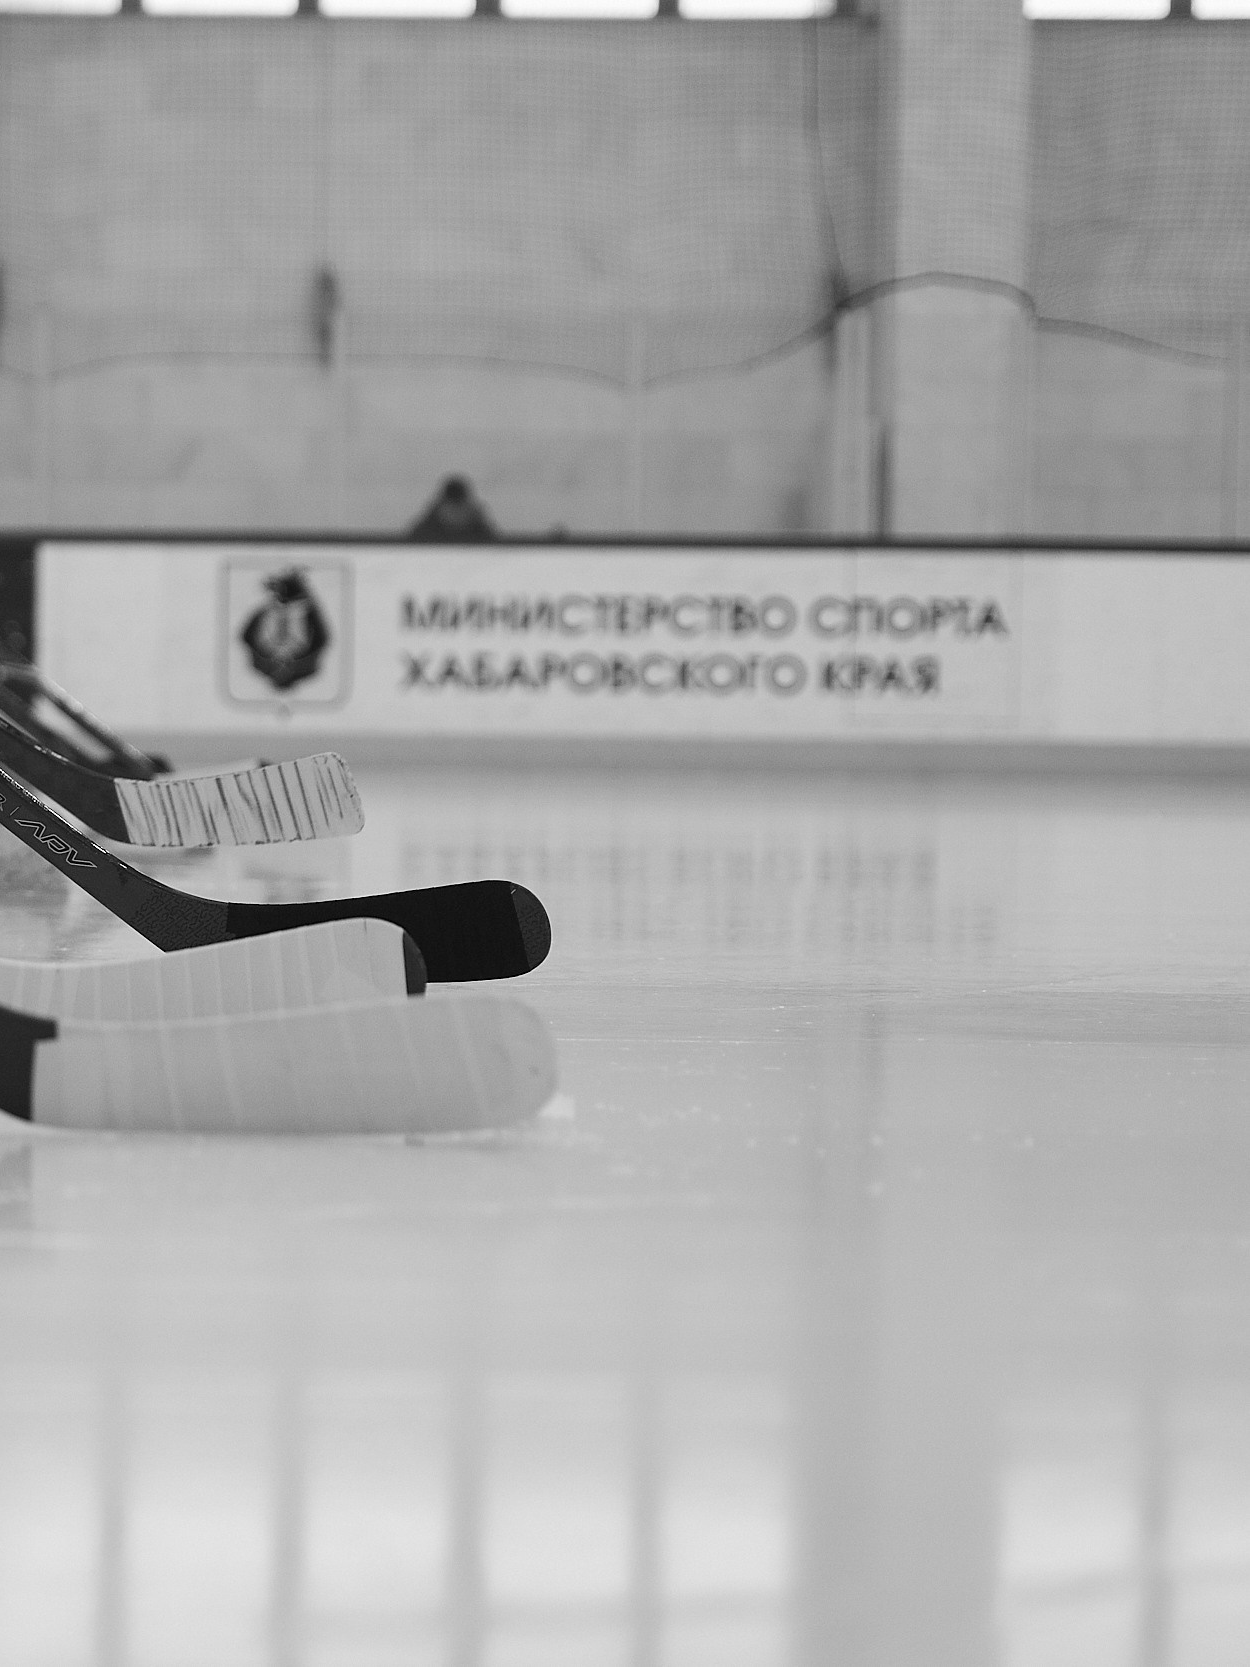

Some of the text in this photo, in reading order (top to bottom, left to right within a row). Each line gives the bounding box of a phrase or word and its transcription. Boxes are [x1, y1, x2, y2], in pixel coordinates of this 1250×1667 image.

[400, 593, 1010, 639] МИНИСТЕРСТВО СПОРТА
[400, 652, 942, 696] ХАБАРОВСКОГО КРАЯ
[14, 818, 97, 869] ADV
